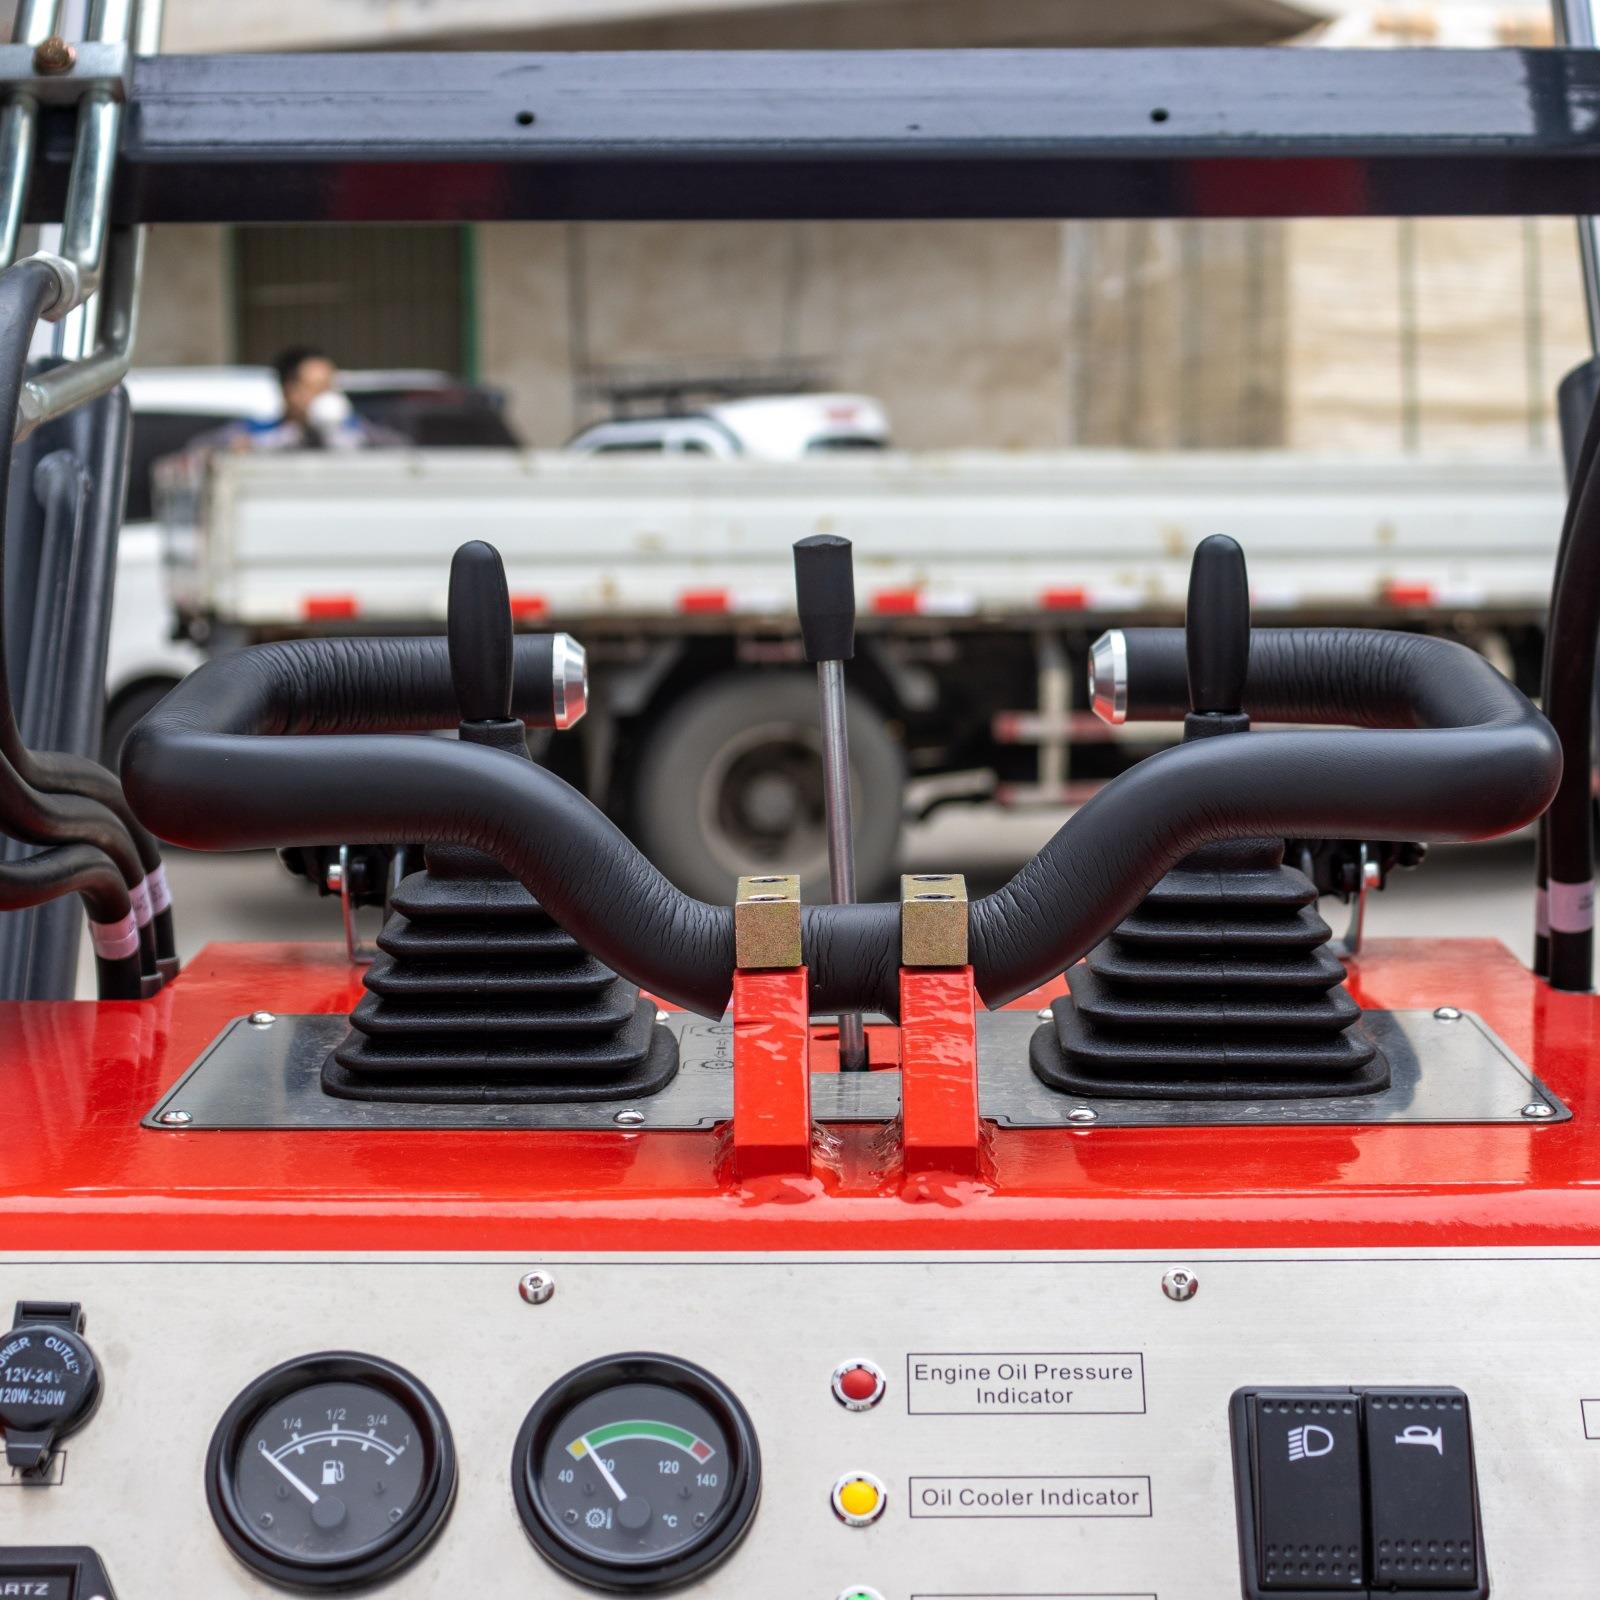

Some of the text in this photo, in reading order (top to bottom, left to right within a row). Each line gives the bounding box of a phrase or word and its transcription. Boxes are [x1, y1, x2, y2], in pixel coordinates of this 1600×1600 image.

[0, 1337, 31, 1368] OWER
[915, 1363, 1133, 1385] Engine Oil Pressure
[977, 1387, 1074, 1404] Indicator
[326, 1408, 347, 1421] 1/2
[367, 1414, 388, 1427] 3/4
[283, 1418, 302, 1430] 1/4
[658, 1460, 680, 1474] 120
[557, 1469, 574, 1483] 40
[696, 1473, 718, 1487] 140
[921, 1488, 1140, 1506] Oil Cooler Indicator
